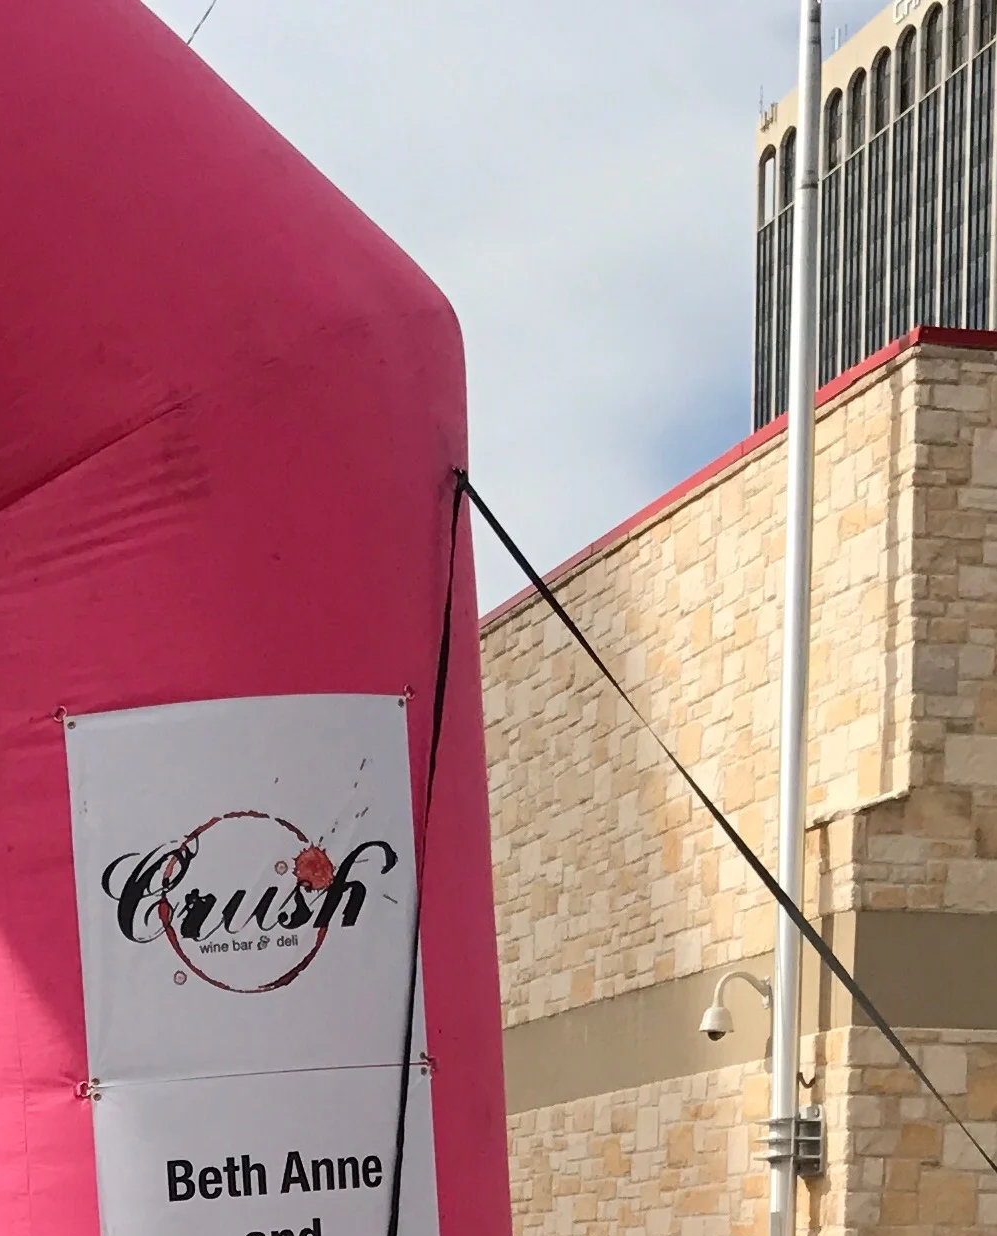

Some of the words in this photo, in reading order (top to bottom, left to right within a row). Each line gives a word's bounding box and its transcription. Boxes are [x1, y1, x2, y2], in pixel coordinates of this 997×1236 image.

[101, 835, 399, 943] Crush
[199, 942, 230, 954] wine
[232, 940, 253, 952] bar
[277, 935, 299, 947] deli
[166, 1154, 268, 1202] Beth
[280, 1151, 383, 1194] Anne
